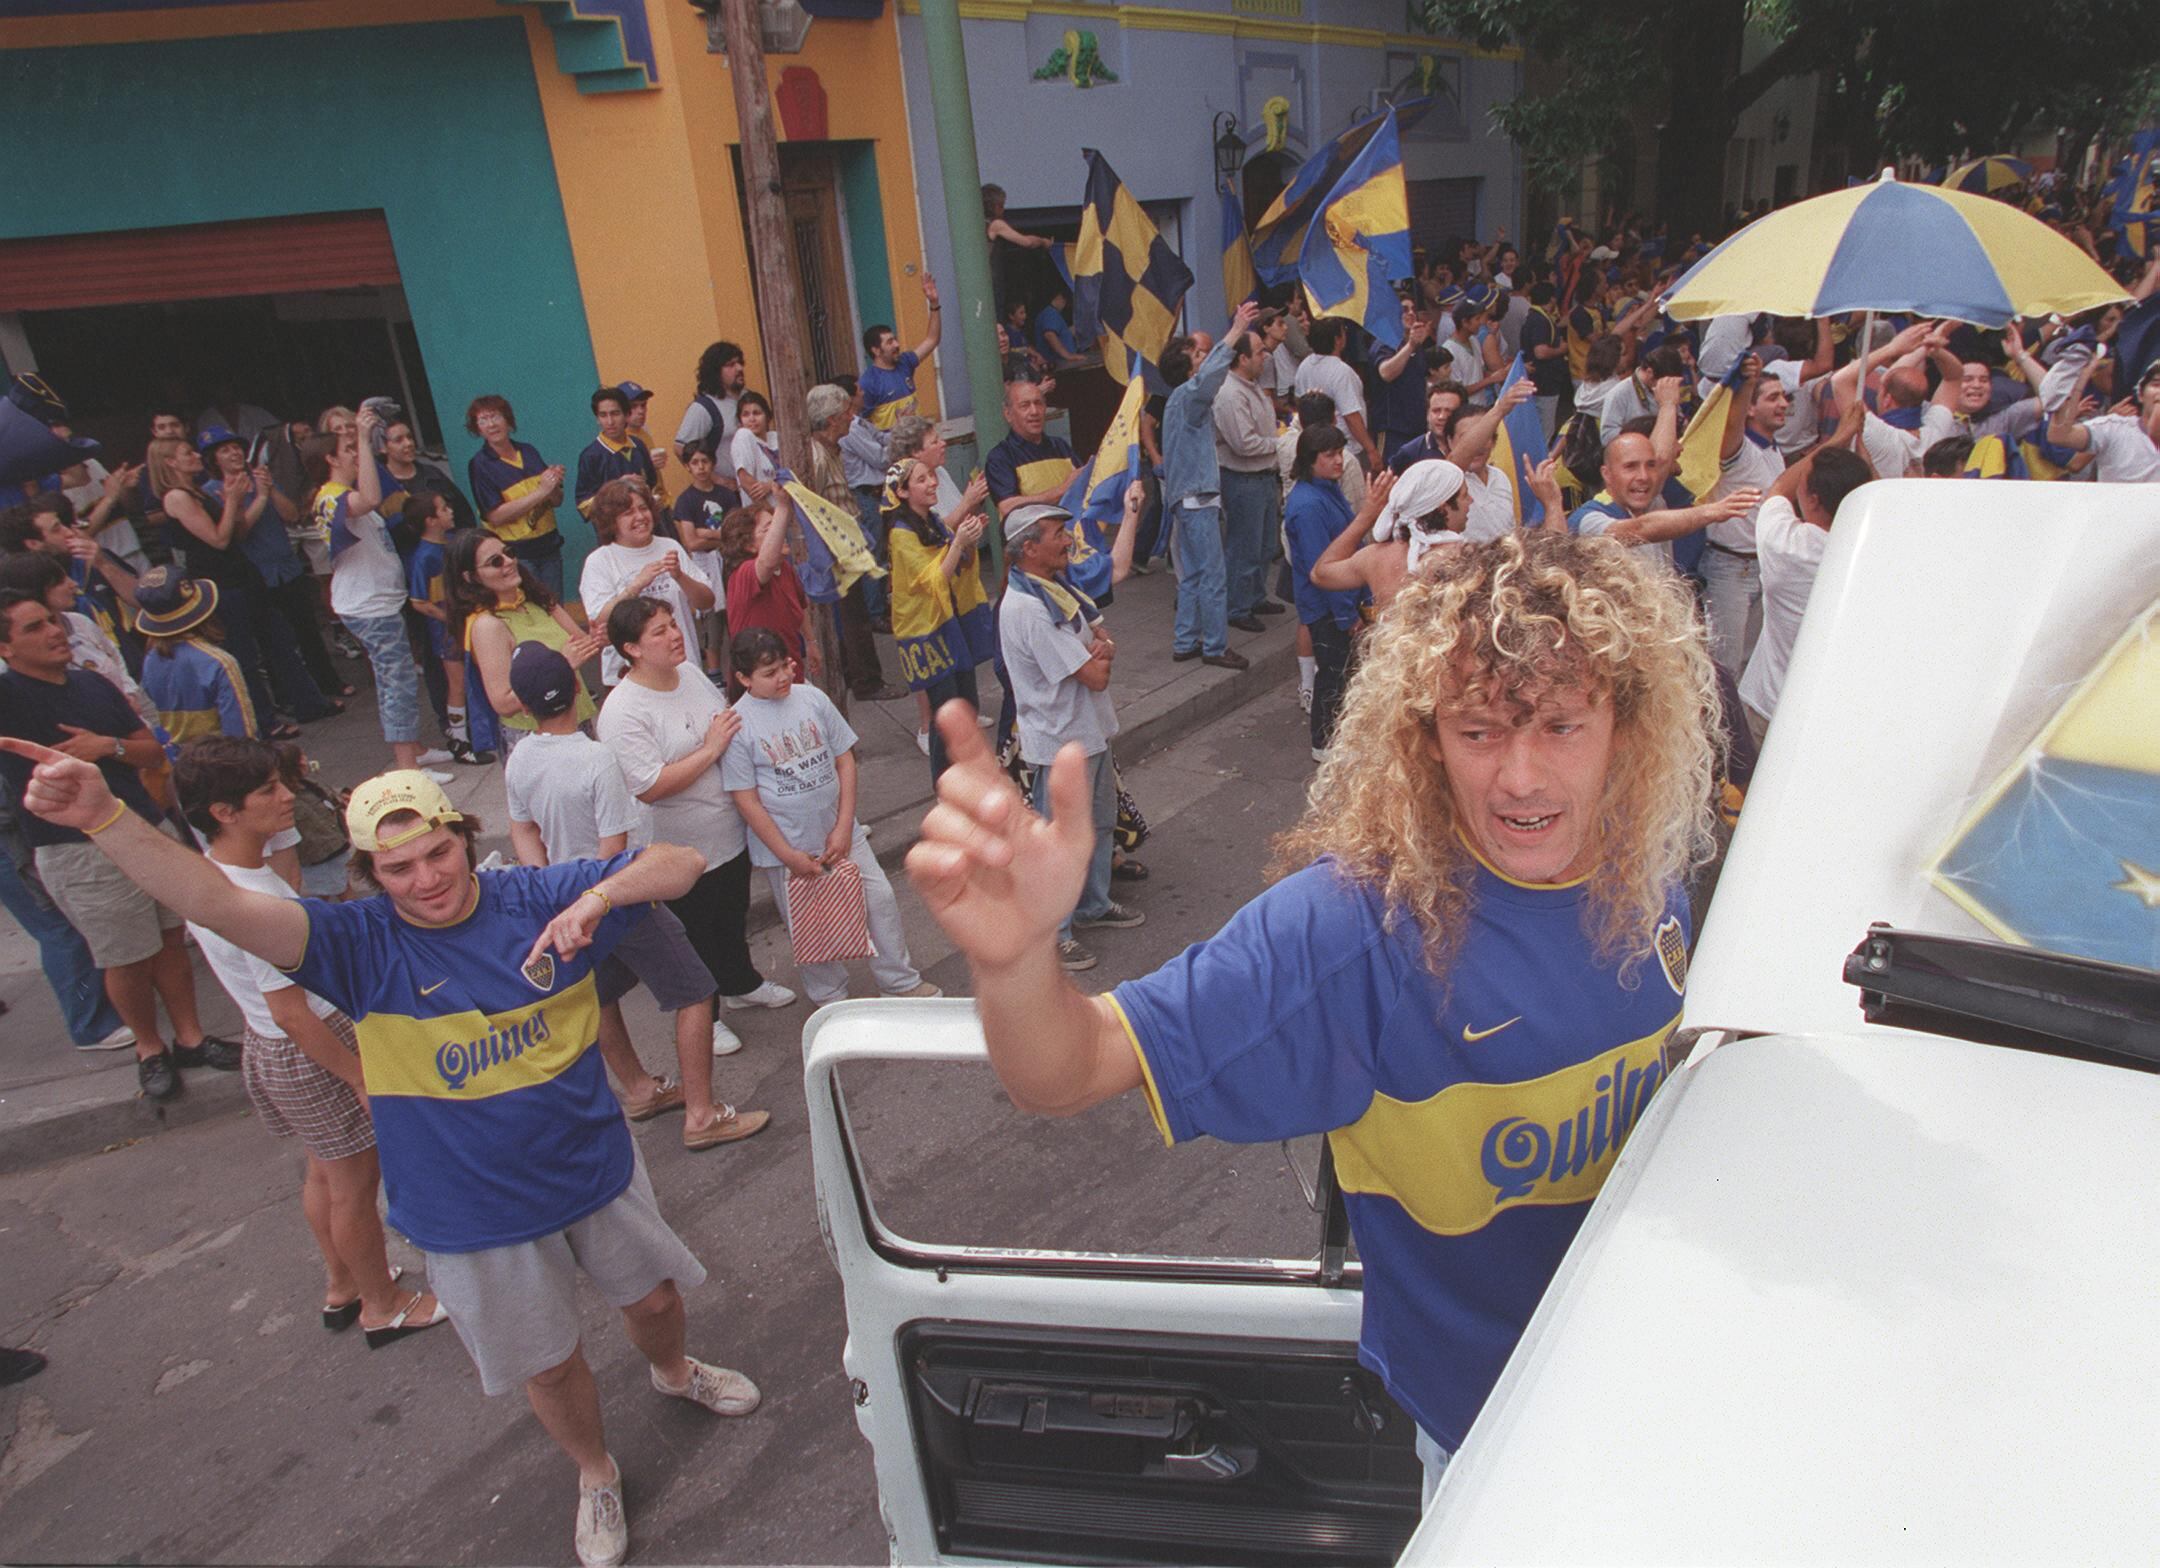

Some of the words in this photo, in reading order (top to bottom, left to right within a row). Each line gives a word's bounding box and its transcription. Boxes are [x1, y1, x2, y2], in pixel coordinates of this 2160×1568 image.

[774, 767, 795, 778] BIG
[798, 750, 829, 770] WAVE
[777, 784, 796, 793] ONE
[799, 779, 817, 790] DAY
[819, 770, 834, 784] ONLY
